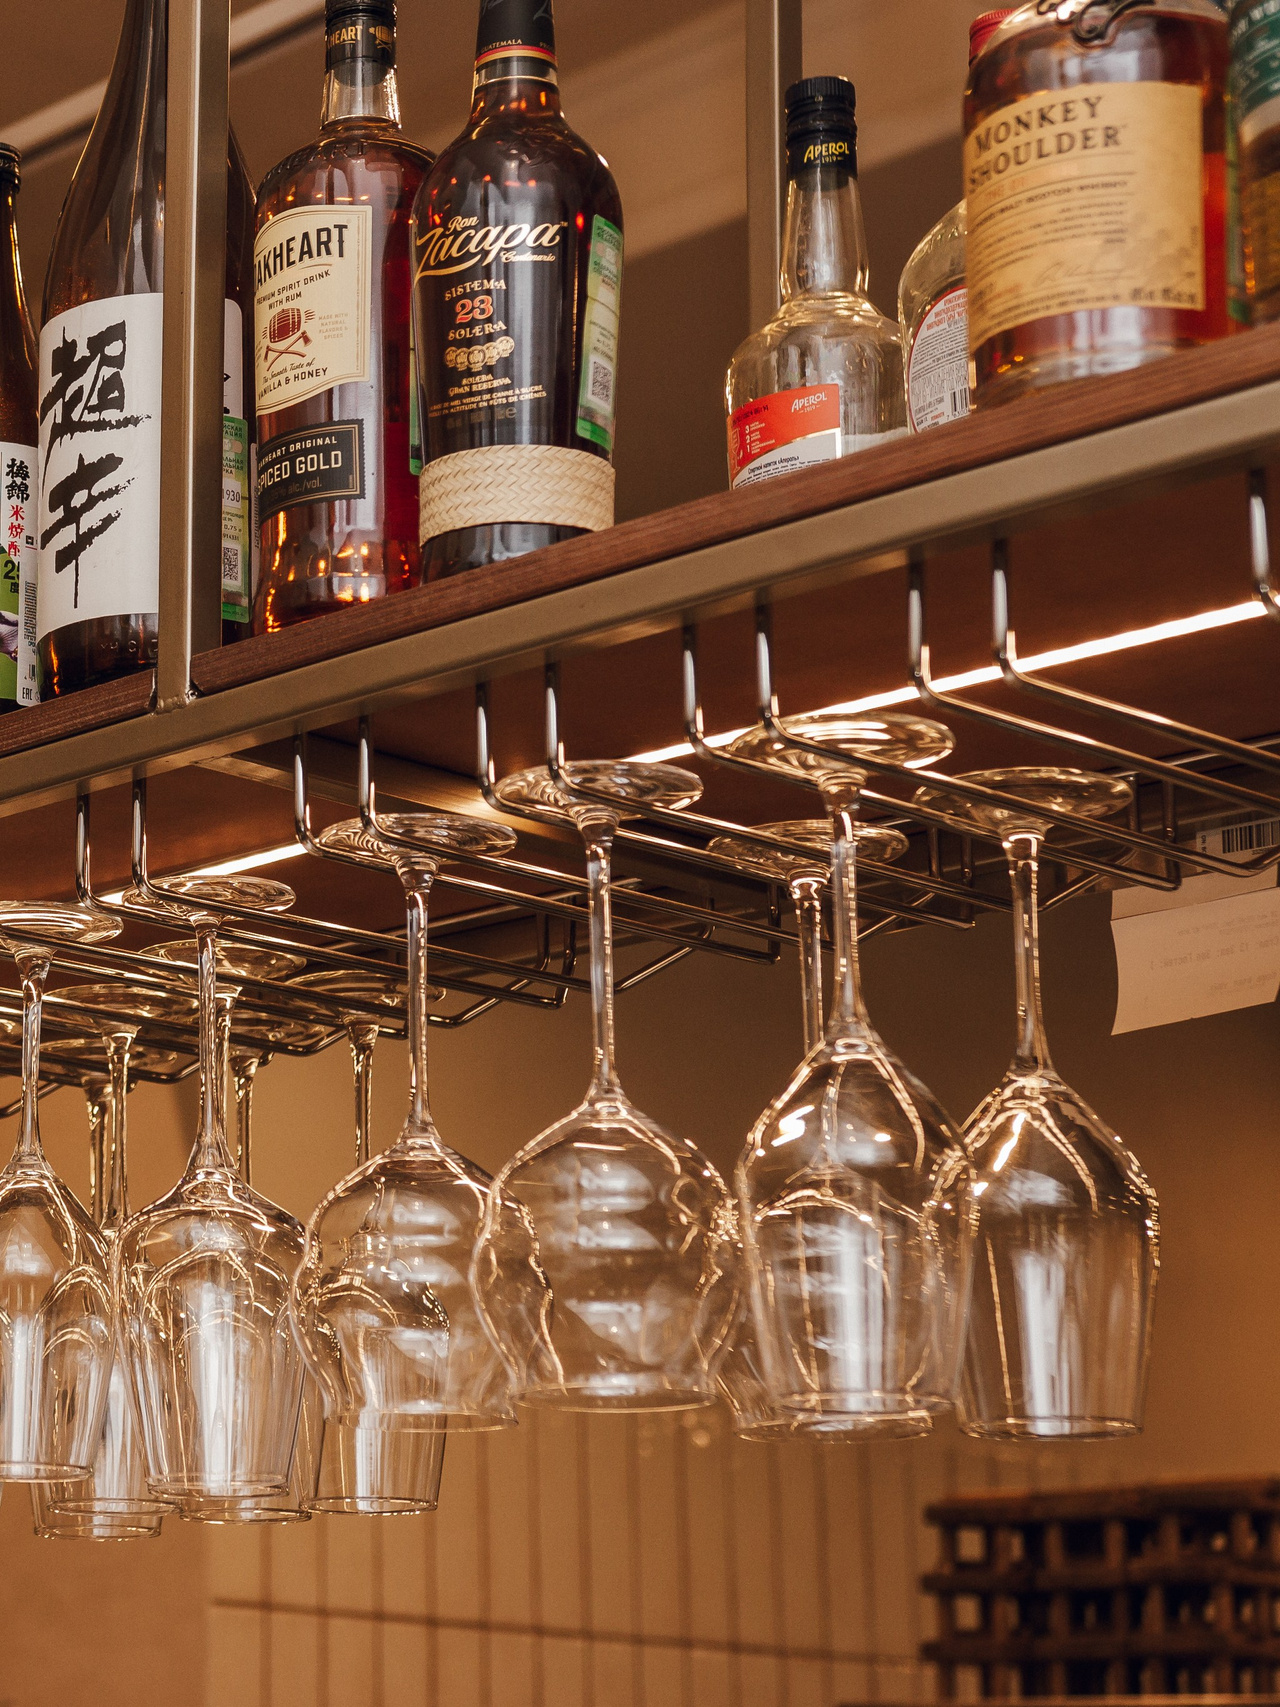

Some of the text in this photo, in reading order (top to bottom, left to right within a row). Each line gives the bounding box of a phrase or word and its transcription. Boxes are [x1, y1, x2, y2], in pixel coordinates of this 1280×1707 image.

[481, 38, 522, 53] GUATEMALA
[974, 95, 1102, 156] MONKEY
[803, 142, 850, 163] APEROL
[969, 125, 1121, 193] SHOULDER
[445, 215, 480, 234] Ron
[414, 221, 561, 288] Zacapa
[277, 281, 300, 296] SPIRIT
[303, 269, 331, 286] DRINK
[444, 278, 507, 301] SISTEMA
[268, 291, 302, 311] WITH RUM
[455, 295, 494, 324] 23
[448, 320, 507, 340] SOLERA
[284, 376, 291, 385] &
[293, 367, 328, 382] HONEY
[471, 377, 512, 392] RESERVA
[791, 391, 828, 413] APEROL
[745, 424, 750, 434] 3
[745, 434, 750, 444] 2
[289, 436, 338, 452] ORIGINAL
[746, 444, 750, 453] 1
[5, 458, 31, 504] 梅錦
[257, 450, 342, 496] SPICED GOLD
